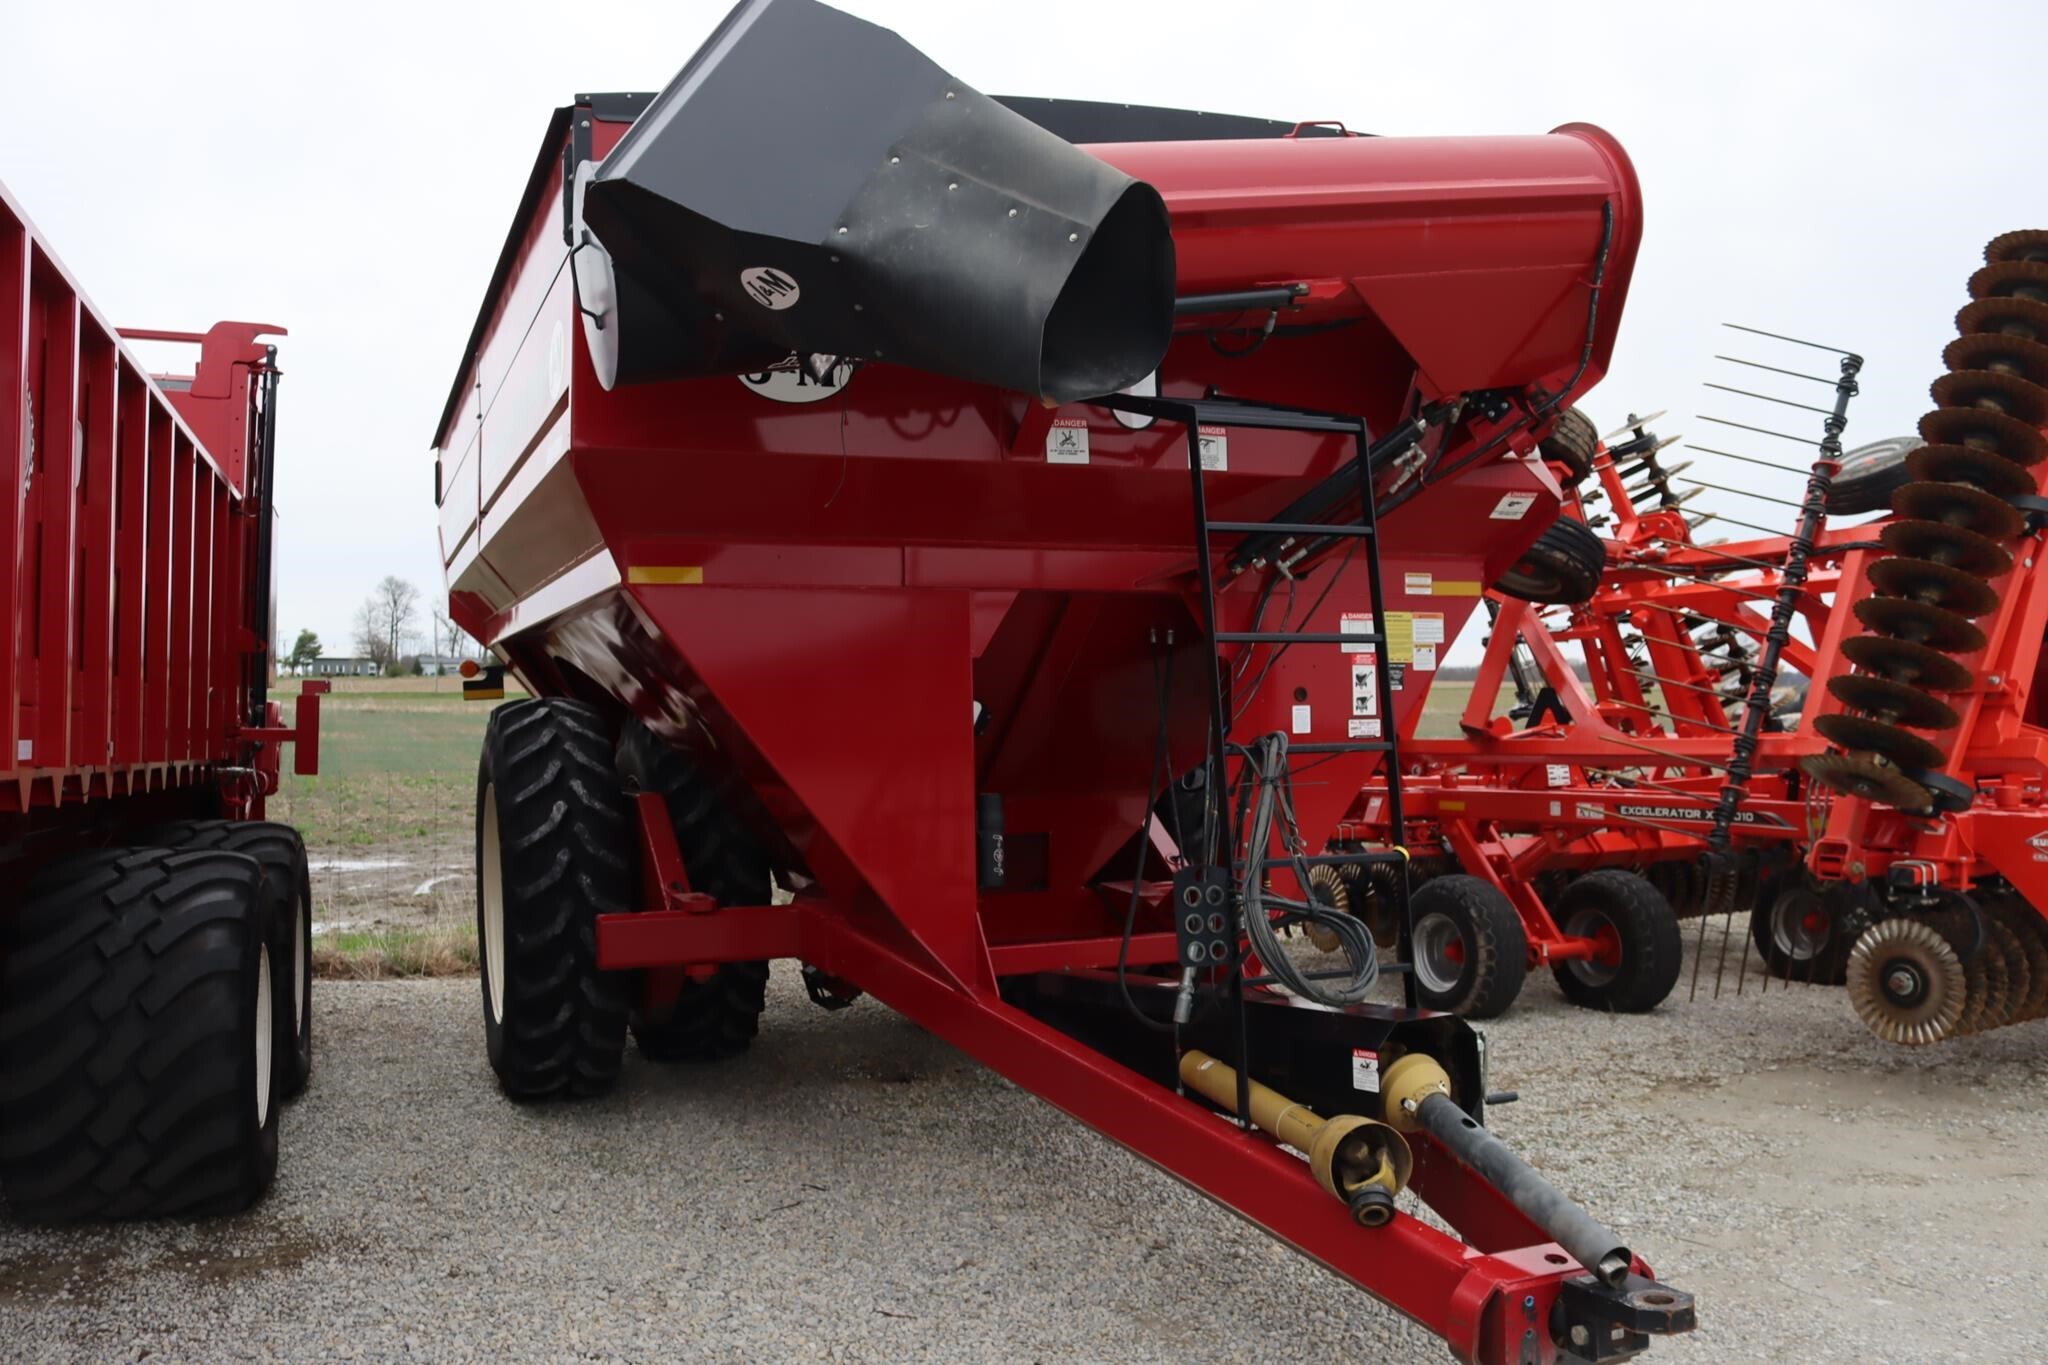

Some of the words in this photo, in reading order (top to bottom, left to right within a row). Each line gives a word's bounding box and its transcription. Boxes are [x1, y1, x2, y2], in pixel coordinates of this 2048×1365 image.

[746, 268, 797, 306] J&M
[1053, 418, 1087, 427] DANGER
[1199, 425, 1226, 435] ANGER
[1620, 805, 1701, 819] EXCELERATOR
[2033, 838, 2048, 848] KU
